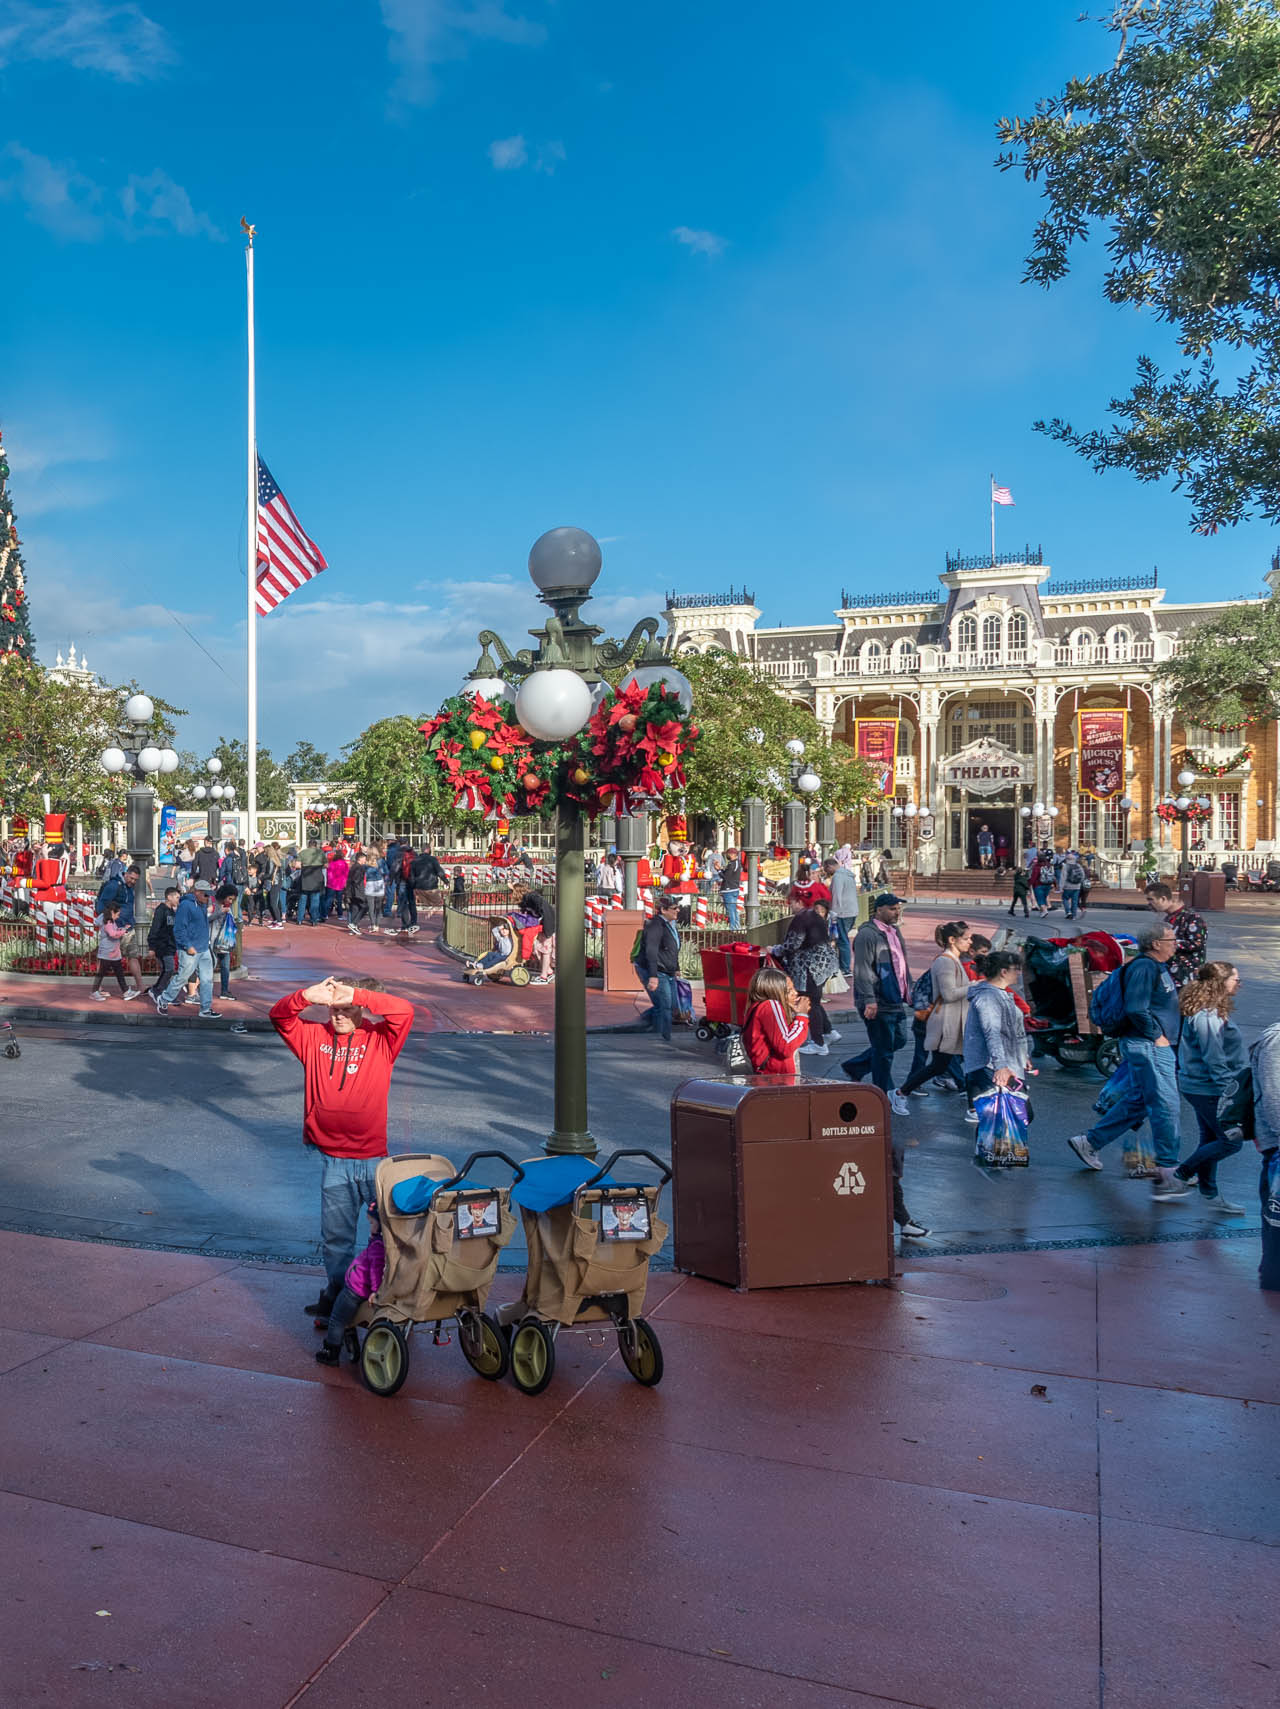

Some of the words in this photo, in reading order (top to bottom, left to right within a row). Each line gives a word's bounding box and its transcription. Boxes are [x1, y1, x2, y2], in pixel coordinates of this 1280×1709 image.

[1082, 749, 1122, 761] MICKEY
[950, 766, 1020, 779] THEATER
[822, 1126, 848, 1137] BOTTLES
[848, 1126, 860, 1135] AND
[860, 1125, 875, 1135] CANS
